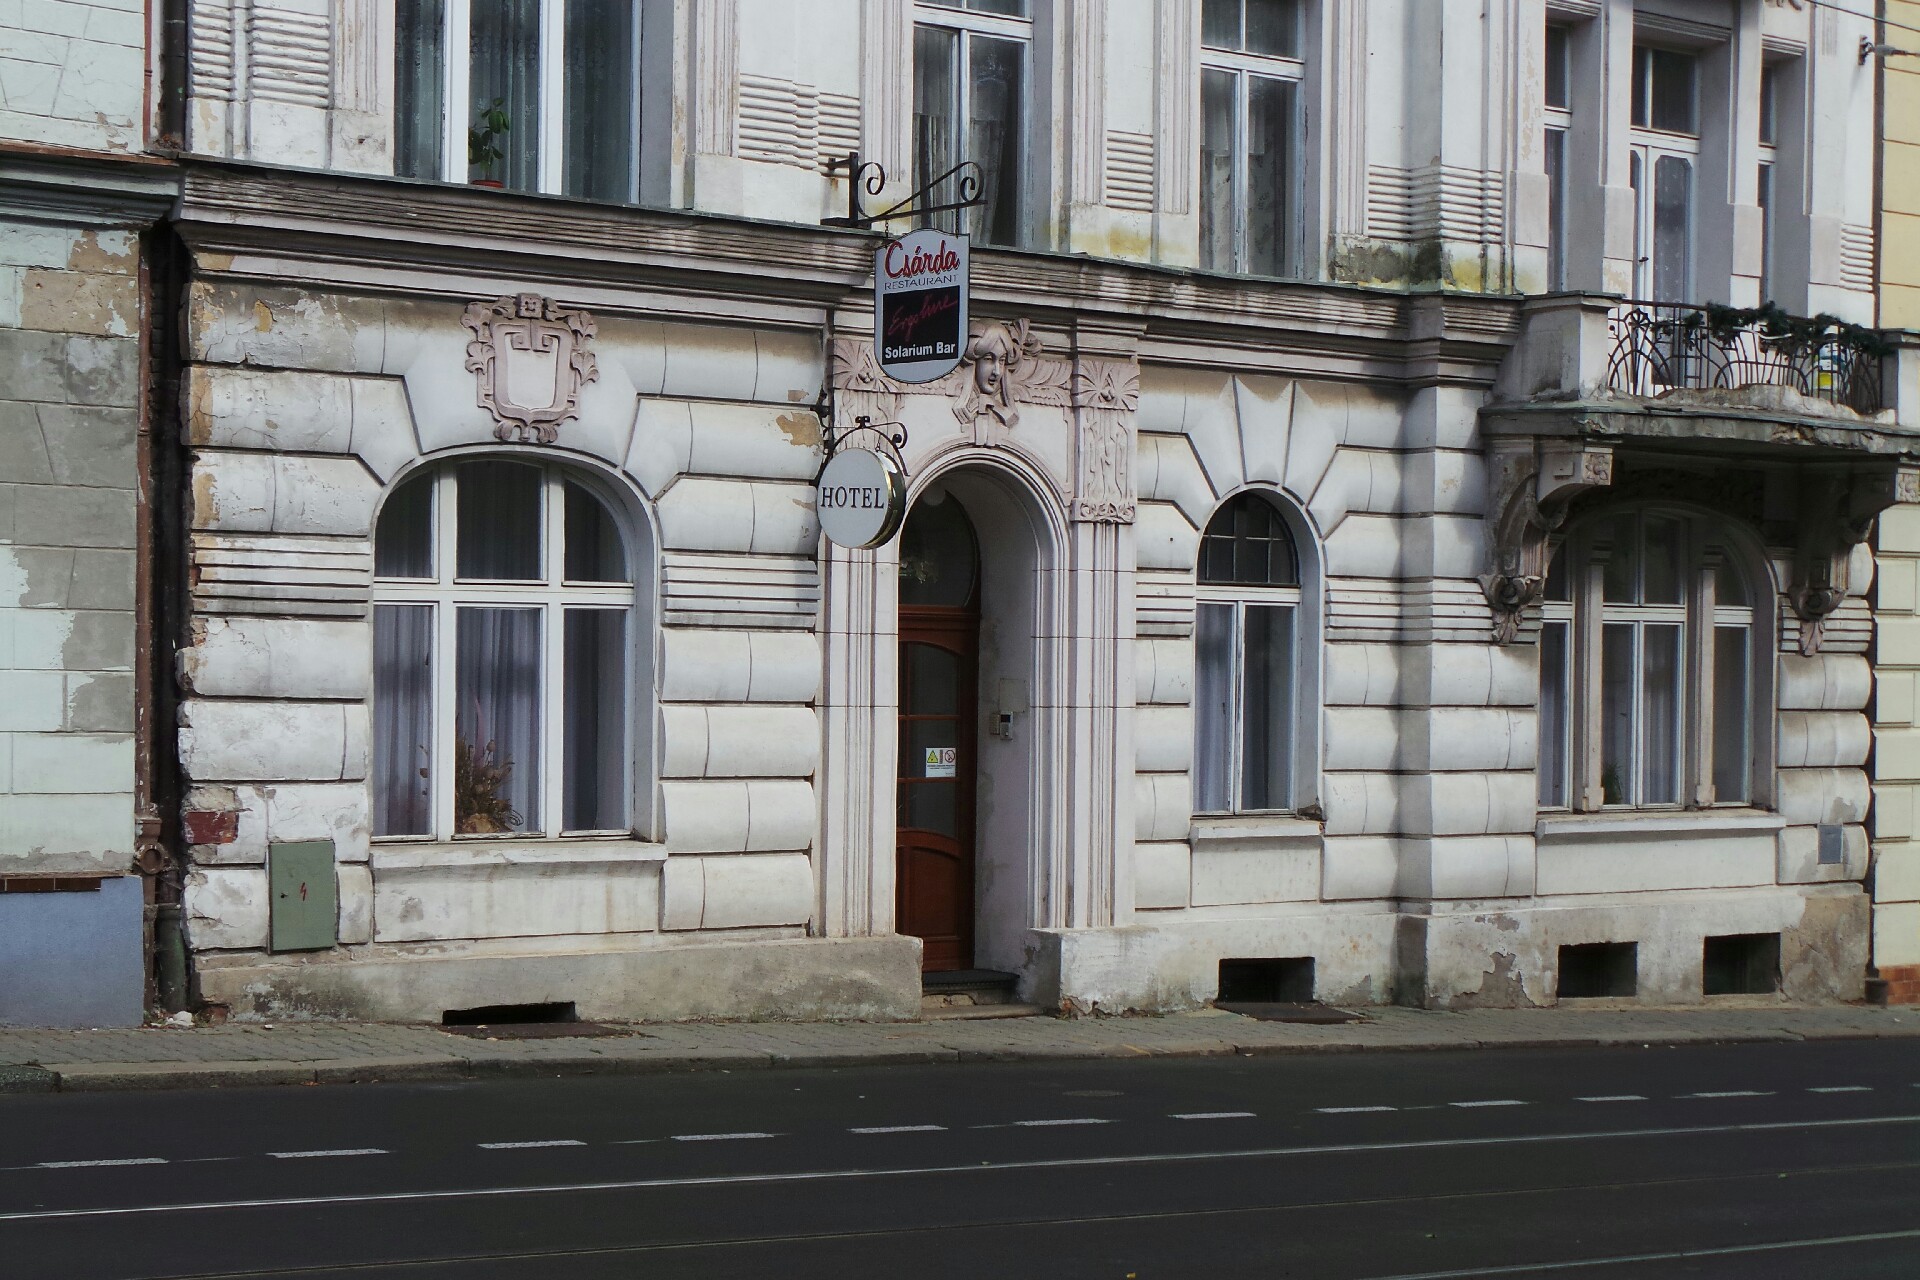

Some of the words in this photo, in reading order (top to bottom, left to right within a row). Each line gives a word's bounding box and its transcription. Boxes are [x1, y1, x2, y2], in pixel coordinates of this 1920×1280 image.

[885, 240, 960, 278] Csárda
[884, 274, 958, 291] RESTAURANT
[885, 343, 933, 359] Solarium
[936, 341, 956, 355] Bar
[820, 486, 884, 508] HOTEL
